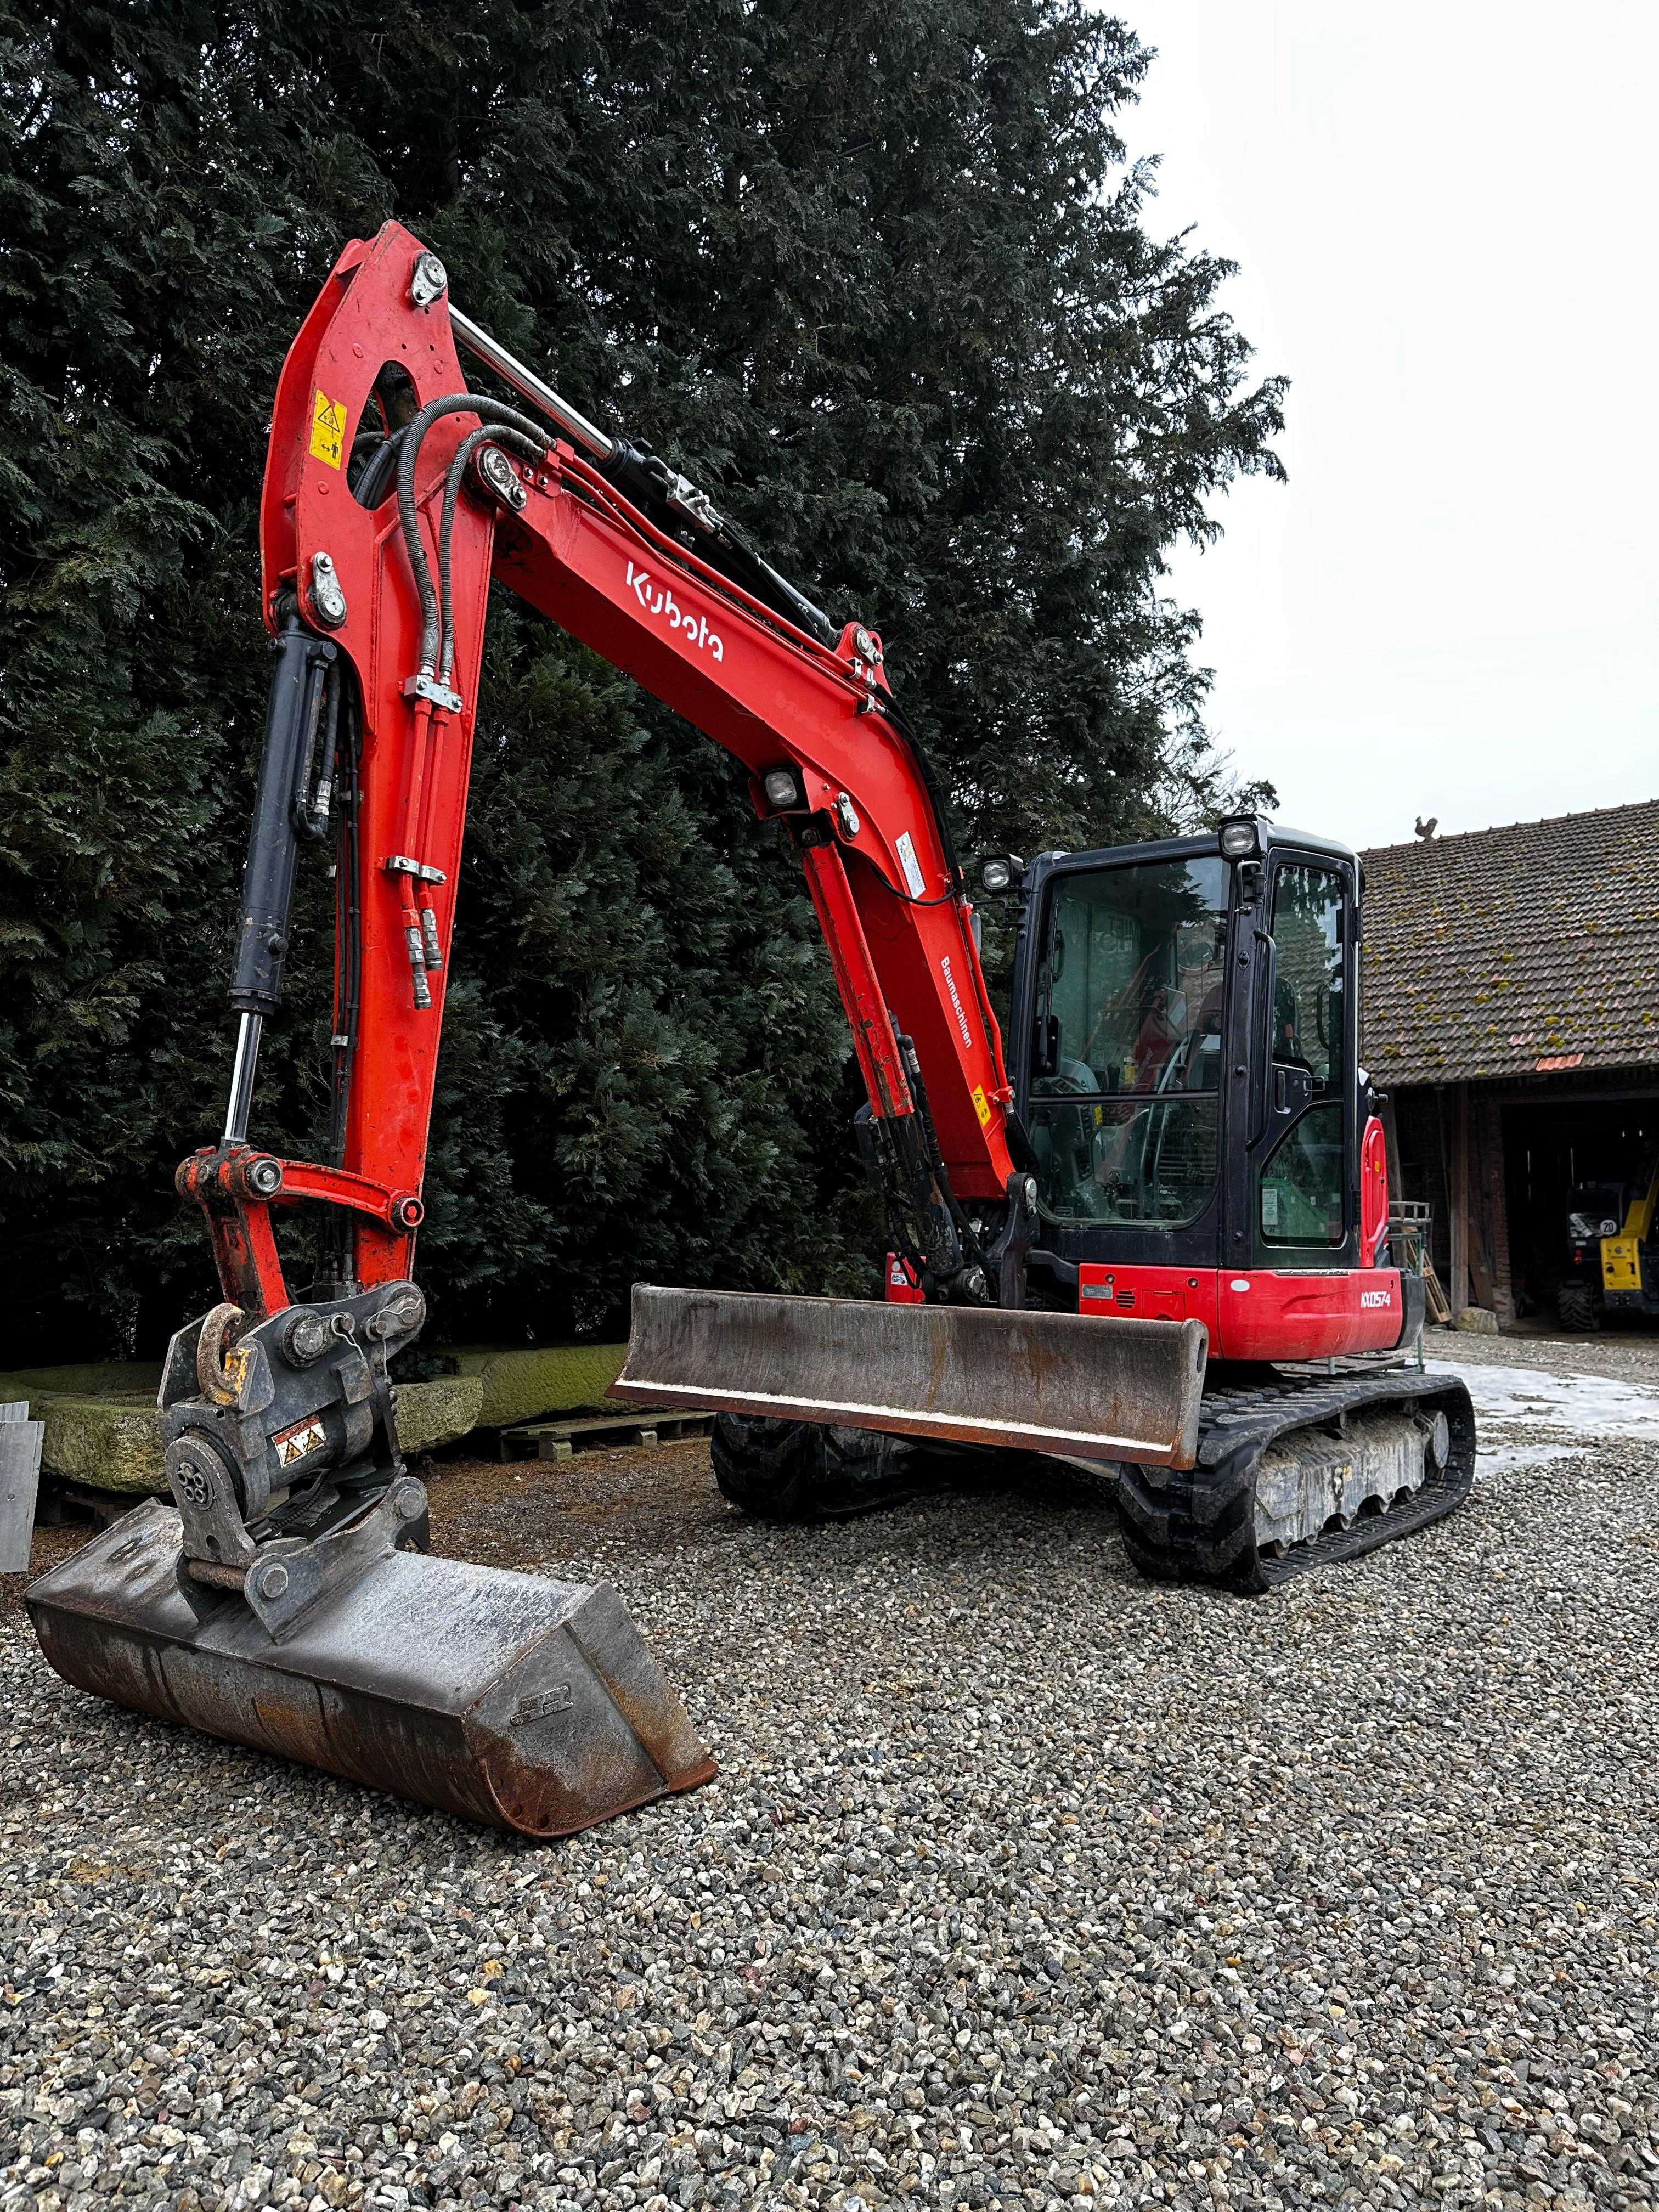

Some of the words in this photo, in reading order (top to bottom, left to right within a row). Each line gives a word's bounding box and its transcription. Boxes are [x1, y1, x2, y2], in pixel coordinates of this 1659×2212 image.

[626, 560, 724, 662] Kubota
[941, 955, 972, 1049] Baumaschinen
[1603, 1222, 1613, 1232] 20
